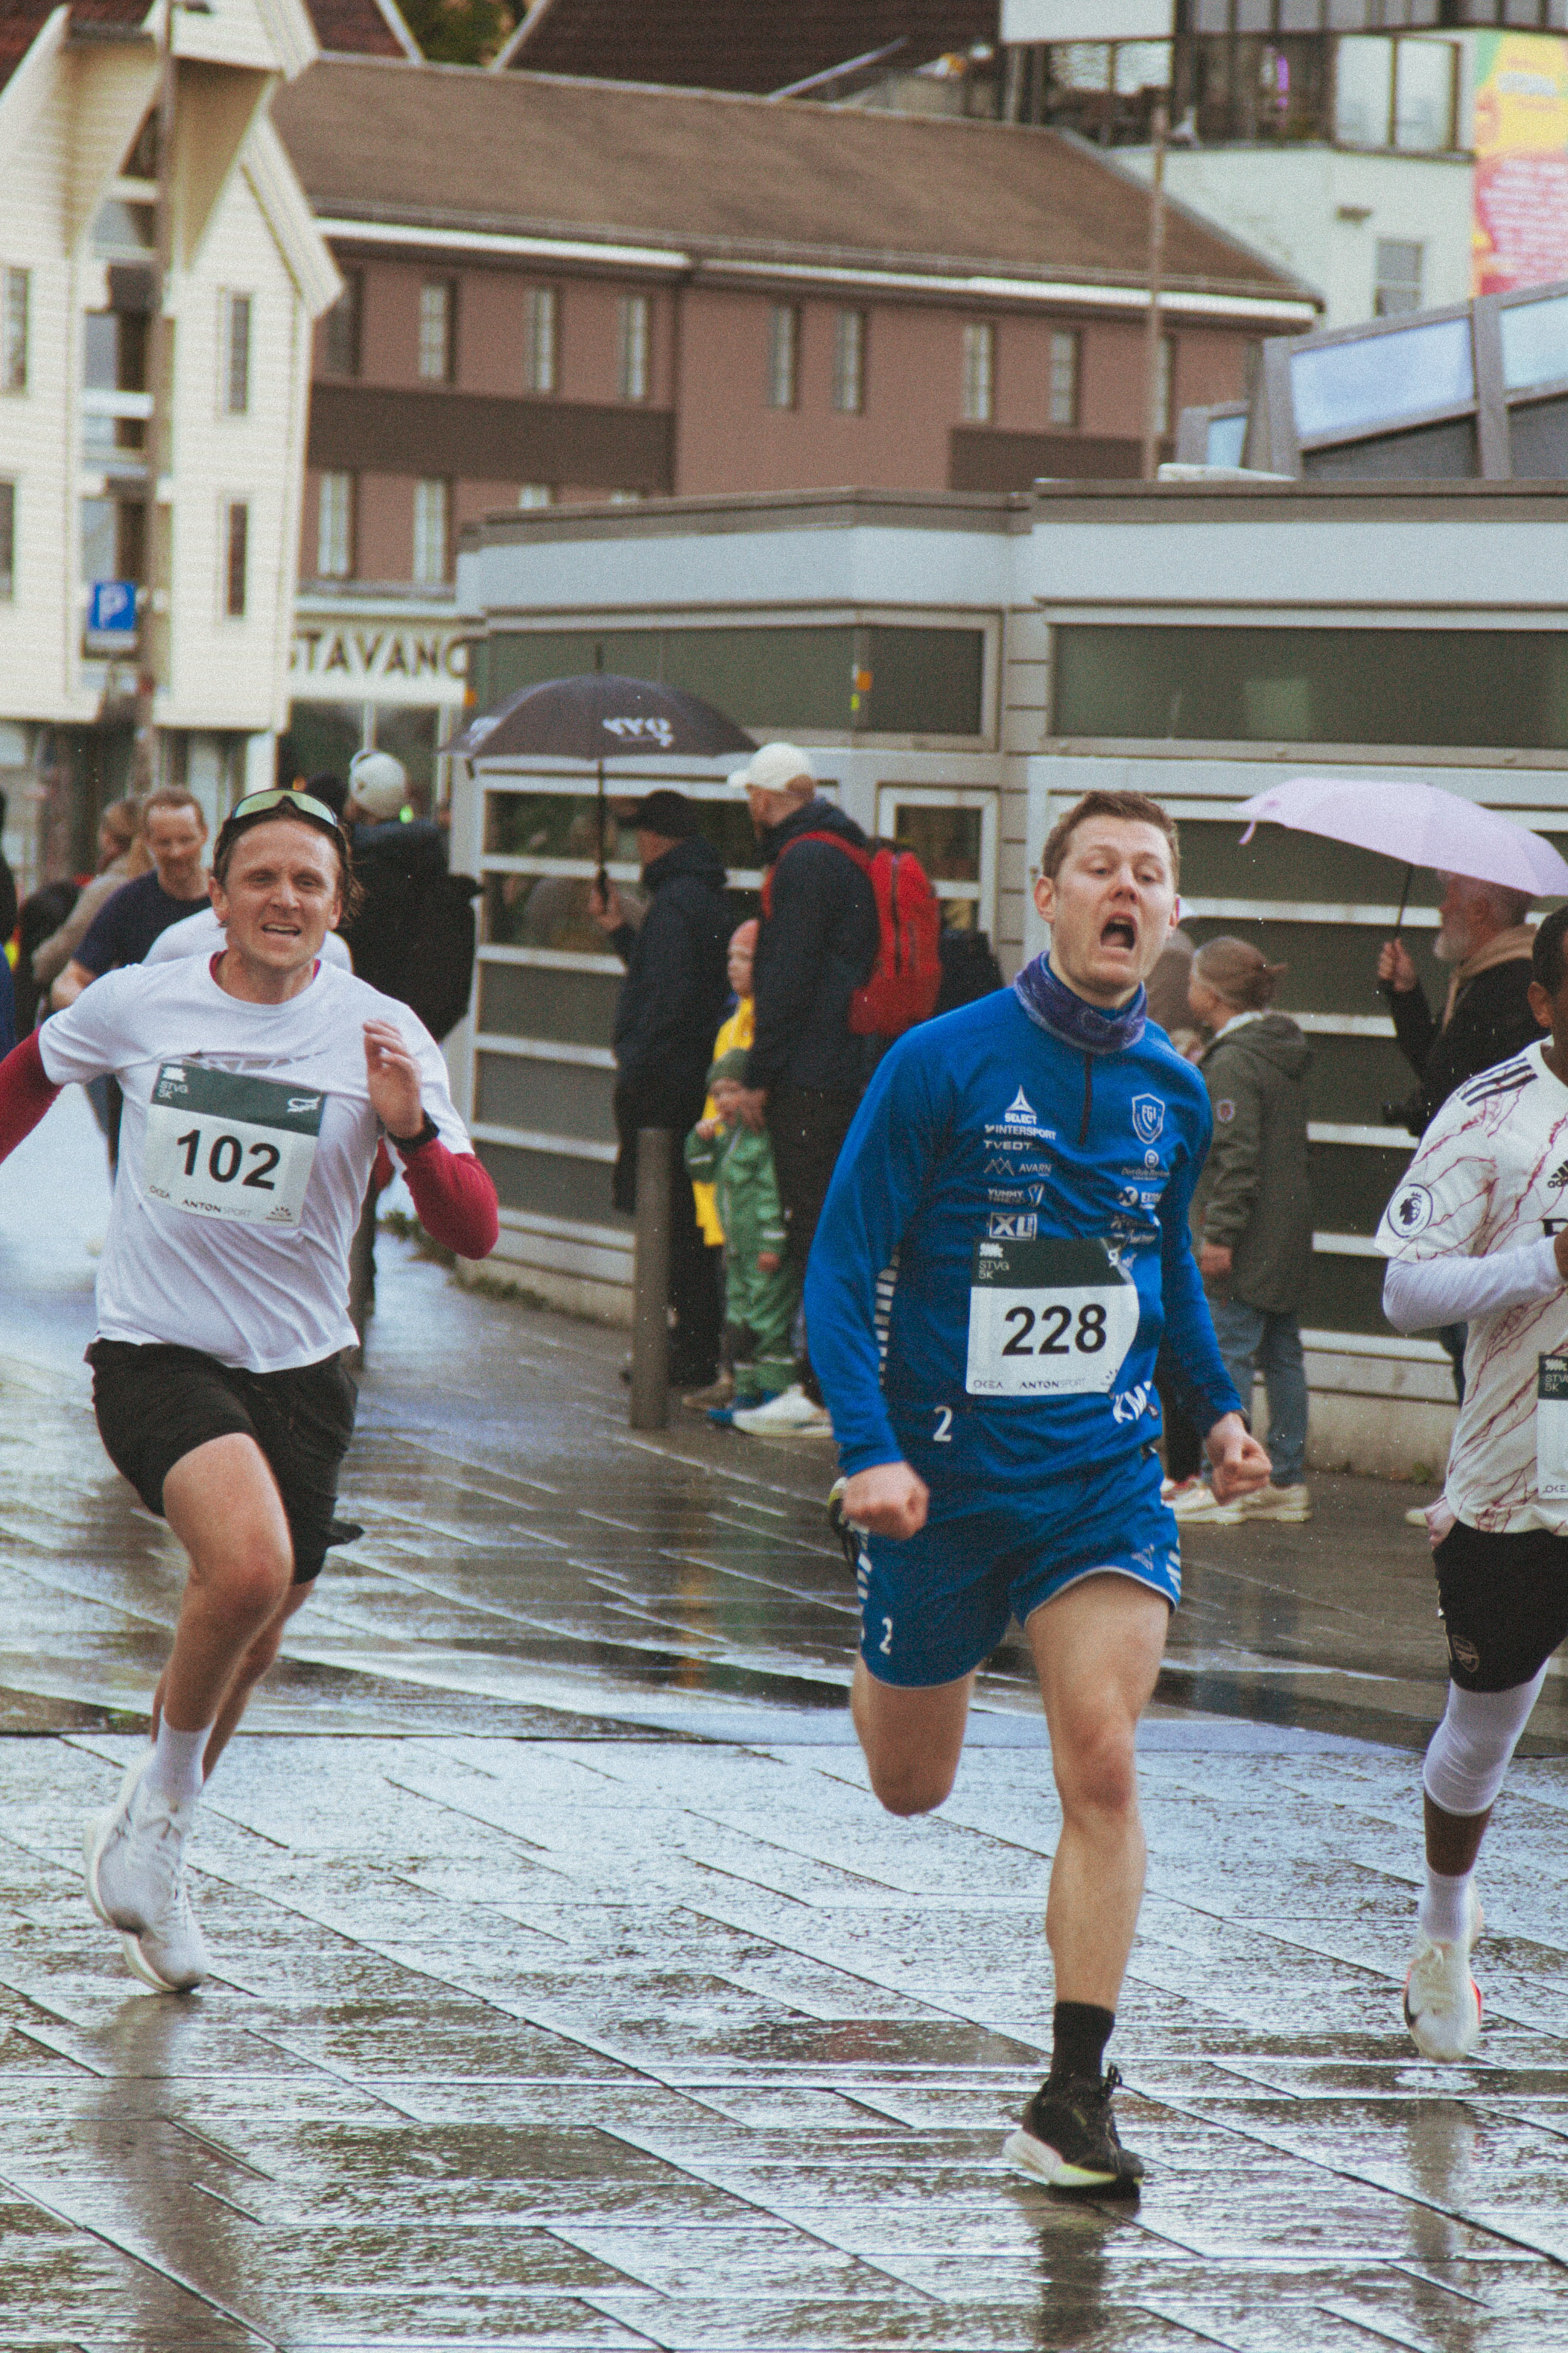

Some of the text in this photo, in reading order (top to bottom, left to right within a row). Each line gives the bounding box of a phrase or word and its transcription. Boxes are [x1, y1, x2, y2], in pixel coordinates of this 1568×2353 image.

[99, 584, 128, 627] P
[995, 1125, 1057, 1141] INTERSPORT
[1004, 1112, 1037, 1125] SELECT
[177, 1129, 282, 1191] 102
[983, 1140, 1031, 1151] TVEDT
[979, 1260, 1010, 1271] STVG
[1002, 1304, 1107, 1357] 228
[933, 1405, 953, 1442] 2
[879, 1617, 893, 1655] 2
